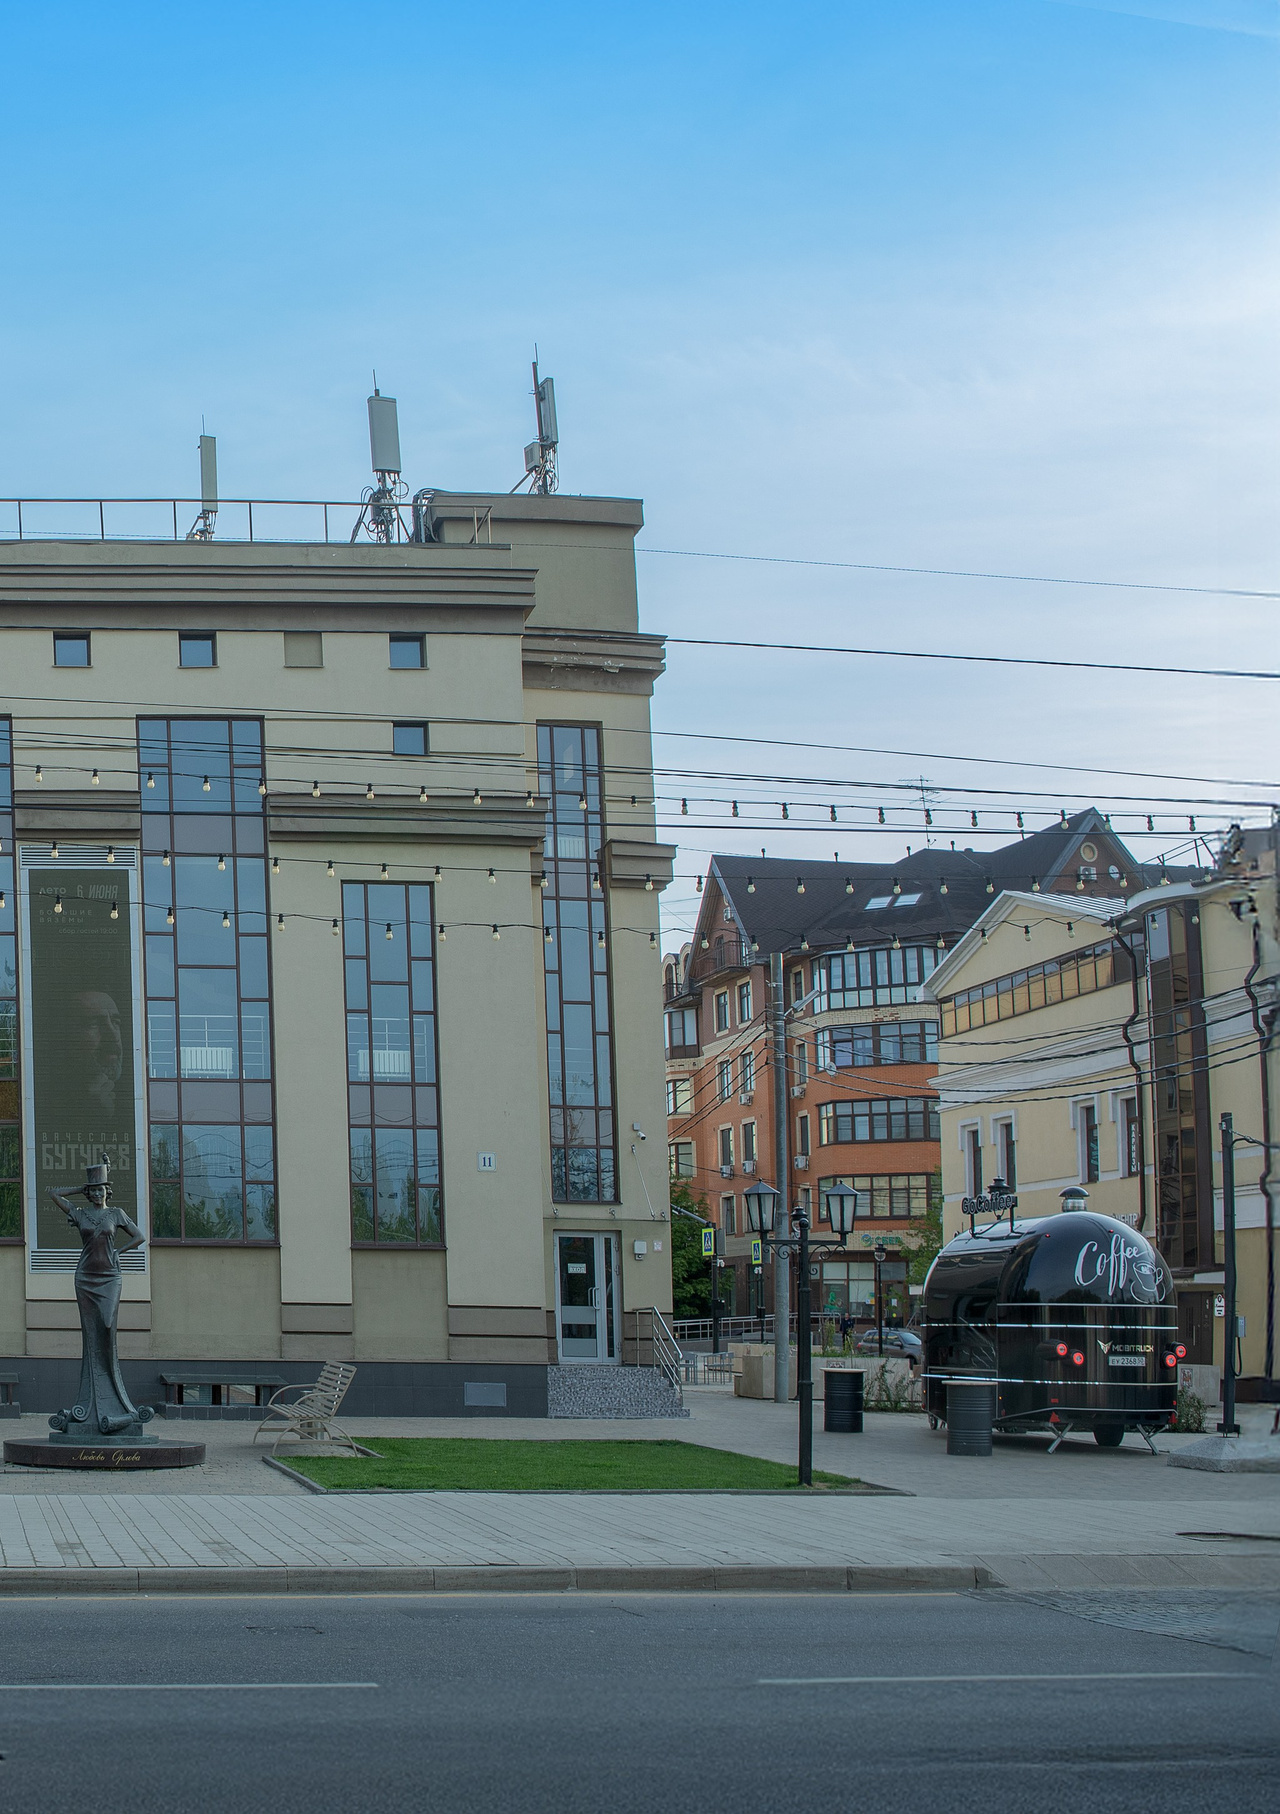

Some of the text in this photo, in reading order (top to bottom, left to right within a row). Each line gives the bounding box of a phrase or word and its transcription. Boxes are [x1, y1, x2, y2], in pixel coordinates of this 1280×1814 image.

[40, 887, 67, 895] лето
[88, 884, 119, 899] ИЮНЯ
[482, 1156, 492, 1168] 11
[1075, 1233, 1145, 1296] Coffee
[1112, 1345, 1154, 1353] MOBITRUCK
